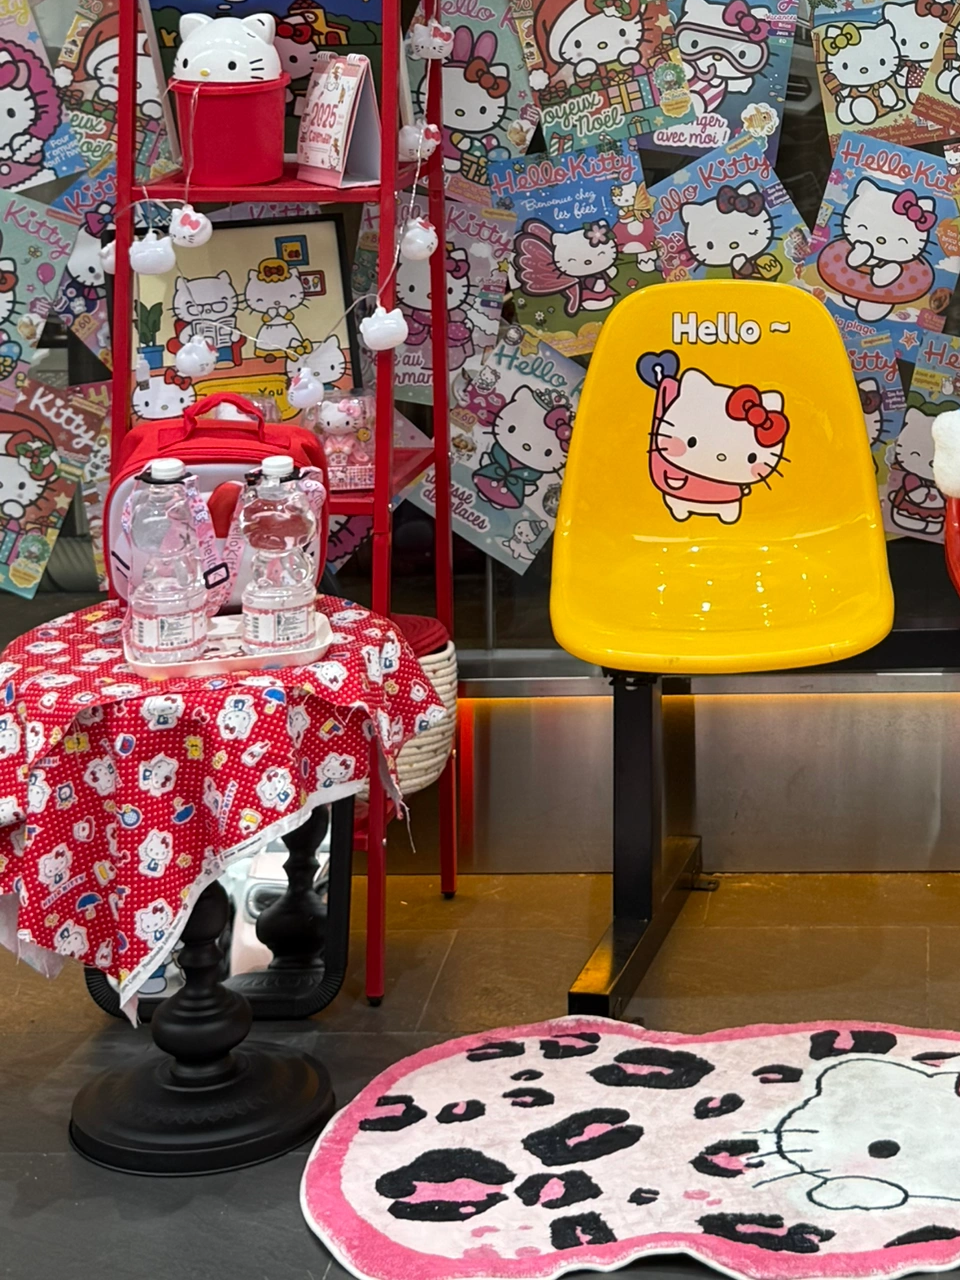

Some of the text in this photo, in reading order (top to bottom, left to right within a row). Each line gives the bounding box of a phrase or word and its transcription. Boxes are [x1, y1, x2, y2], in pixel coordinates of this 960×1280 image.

[311, 101, 339, 130] 2025
[577, 109, 624, 135] Noël
[656, 129, 721, 147] avec moi
[491, 151, 637, 197] Hello Kitty
[698, 151, 773, 189] Kitty
[840, 139, 914, 178] Hello
[553, 203, 598, 221] les fées
[575, 188, 597, 205] chez
[5, 199, 71, 261] Kitty
[447, 208, 516, 255] Kitty
[671, 312, 761, 345] Hello
[496, 343, 569, 390] Hello
[258, 385, 284, 399] You
[31, 386, 98, 450] Kitty
